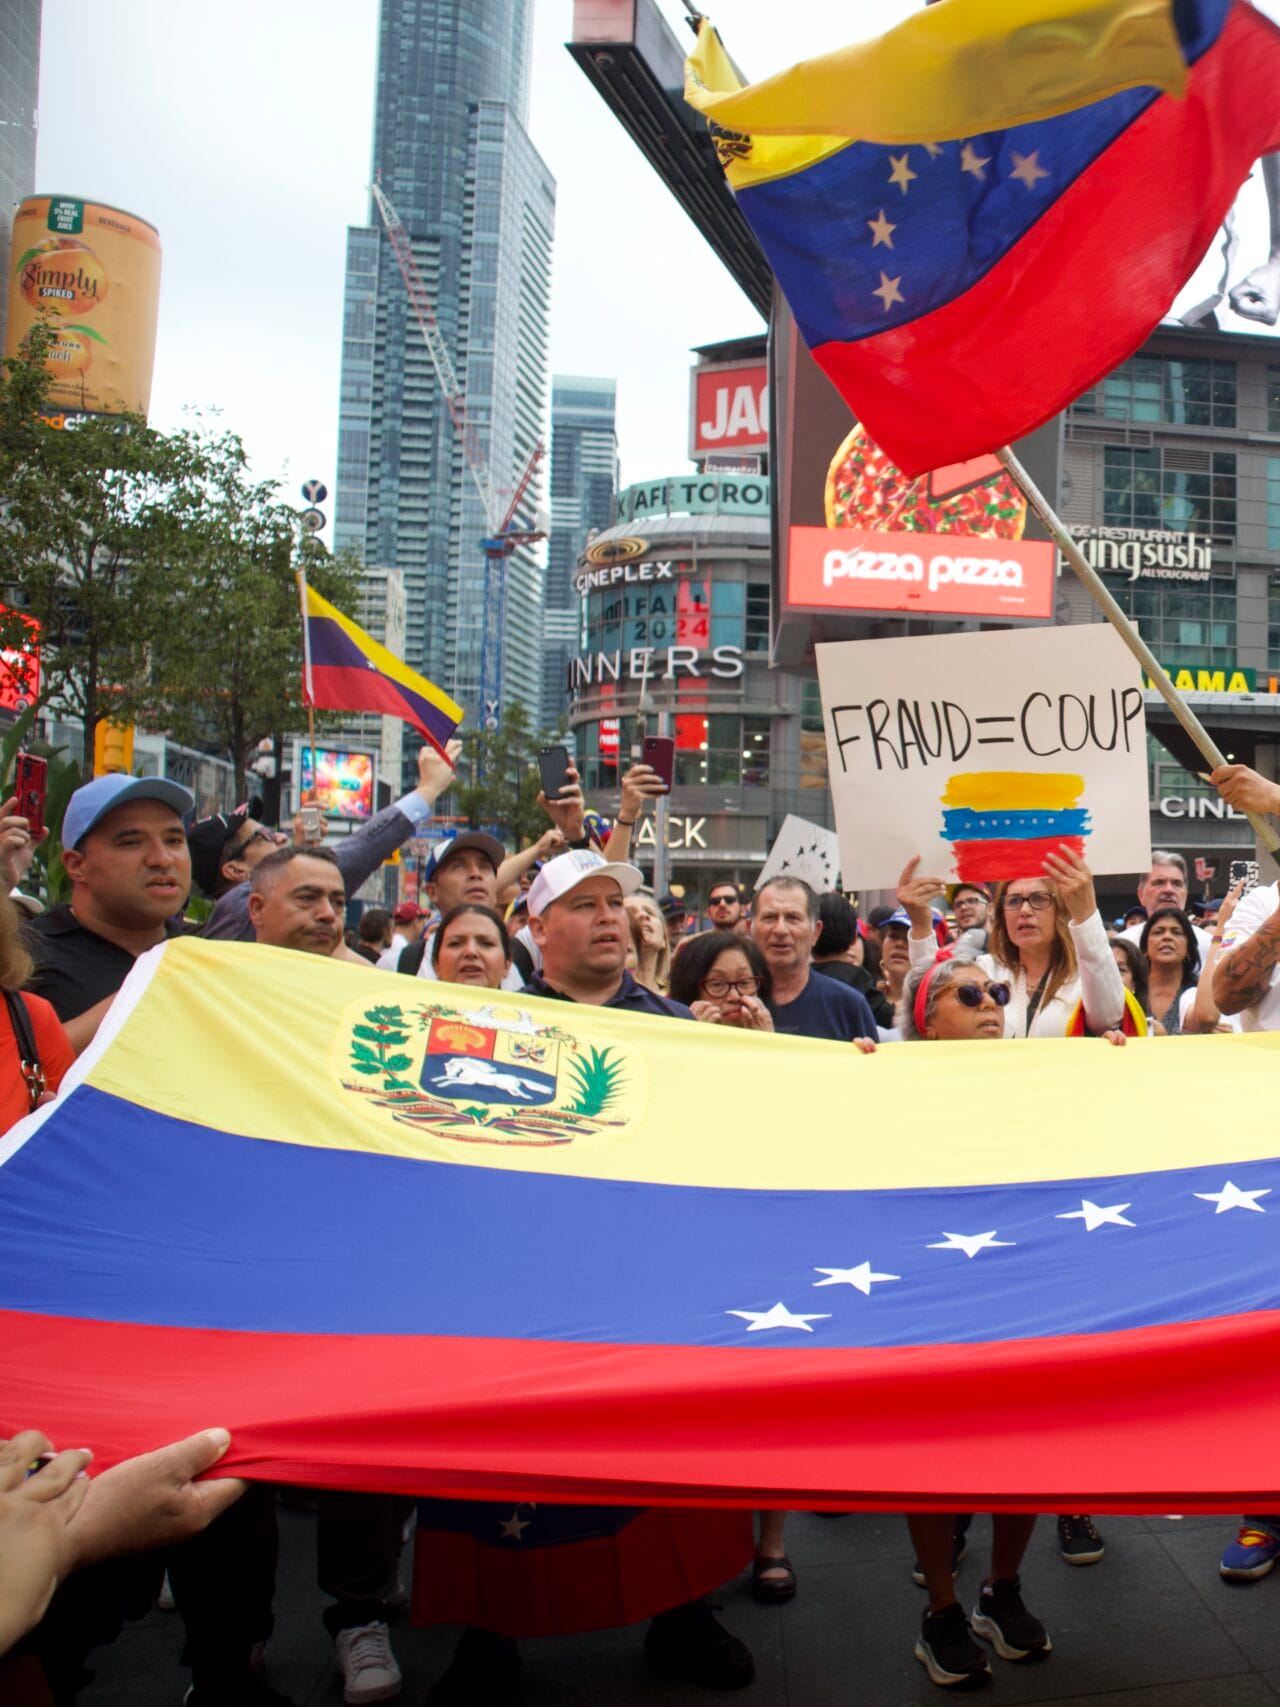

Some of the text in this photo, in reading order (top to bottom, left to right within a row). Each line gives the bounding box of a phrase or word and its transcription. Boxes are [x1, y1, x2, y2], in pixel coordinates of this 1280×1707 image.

[23, 262, 100, 301] Simply
[42, 288, 73, 299] SPIKED
[1098, 526, 1185, 543] RESTAURANT
[1143, 532, 1212, 571] sushi
[576, 561, 673, 592] CINEPLEX
[823, 549, 1024, 592] pizza pizza
[634, 619, 709, 640] 2024
